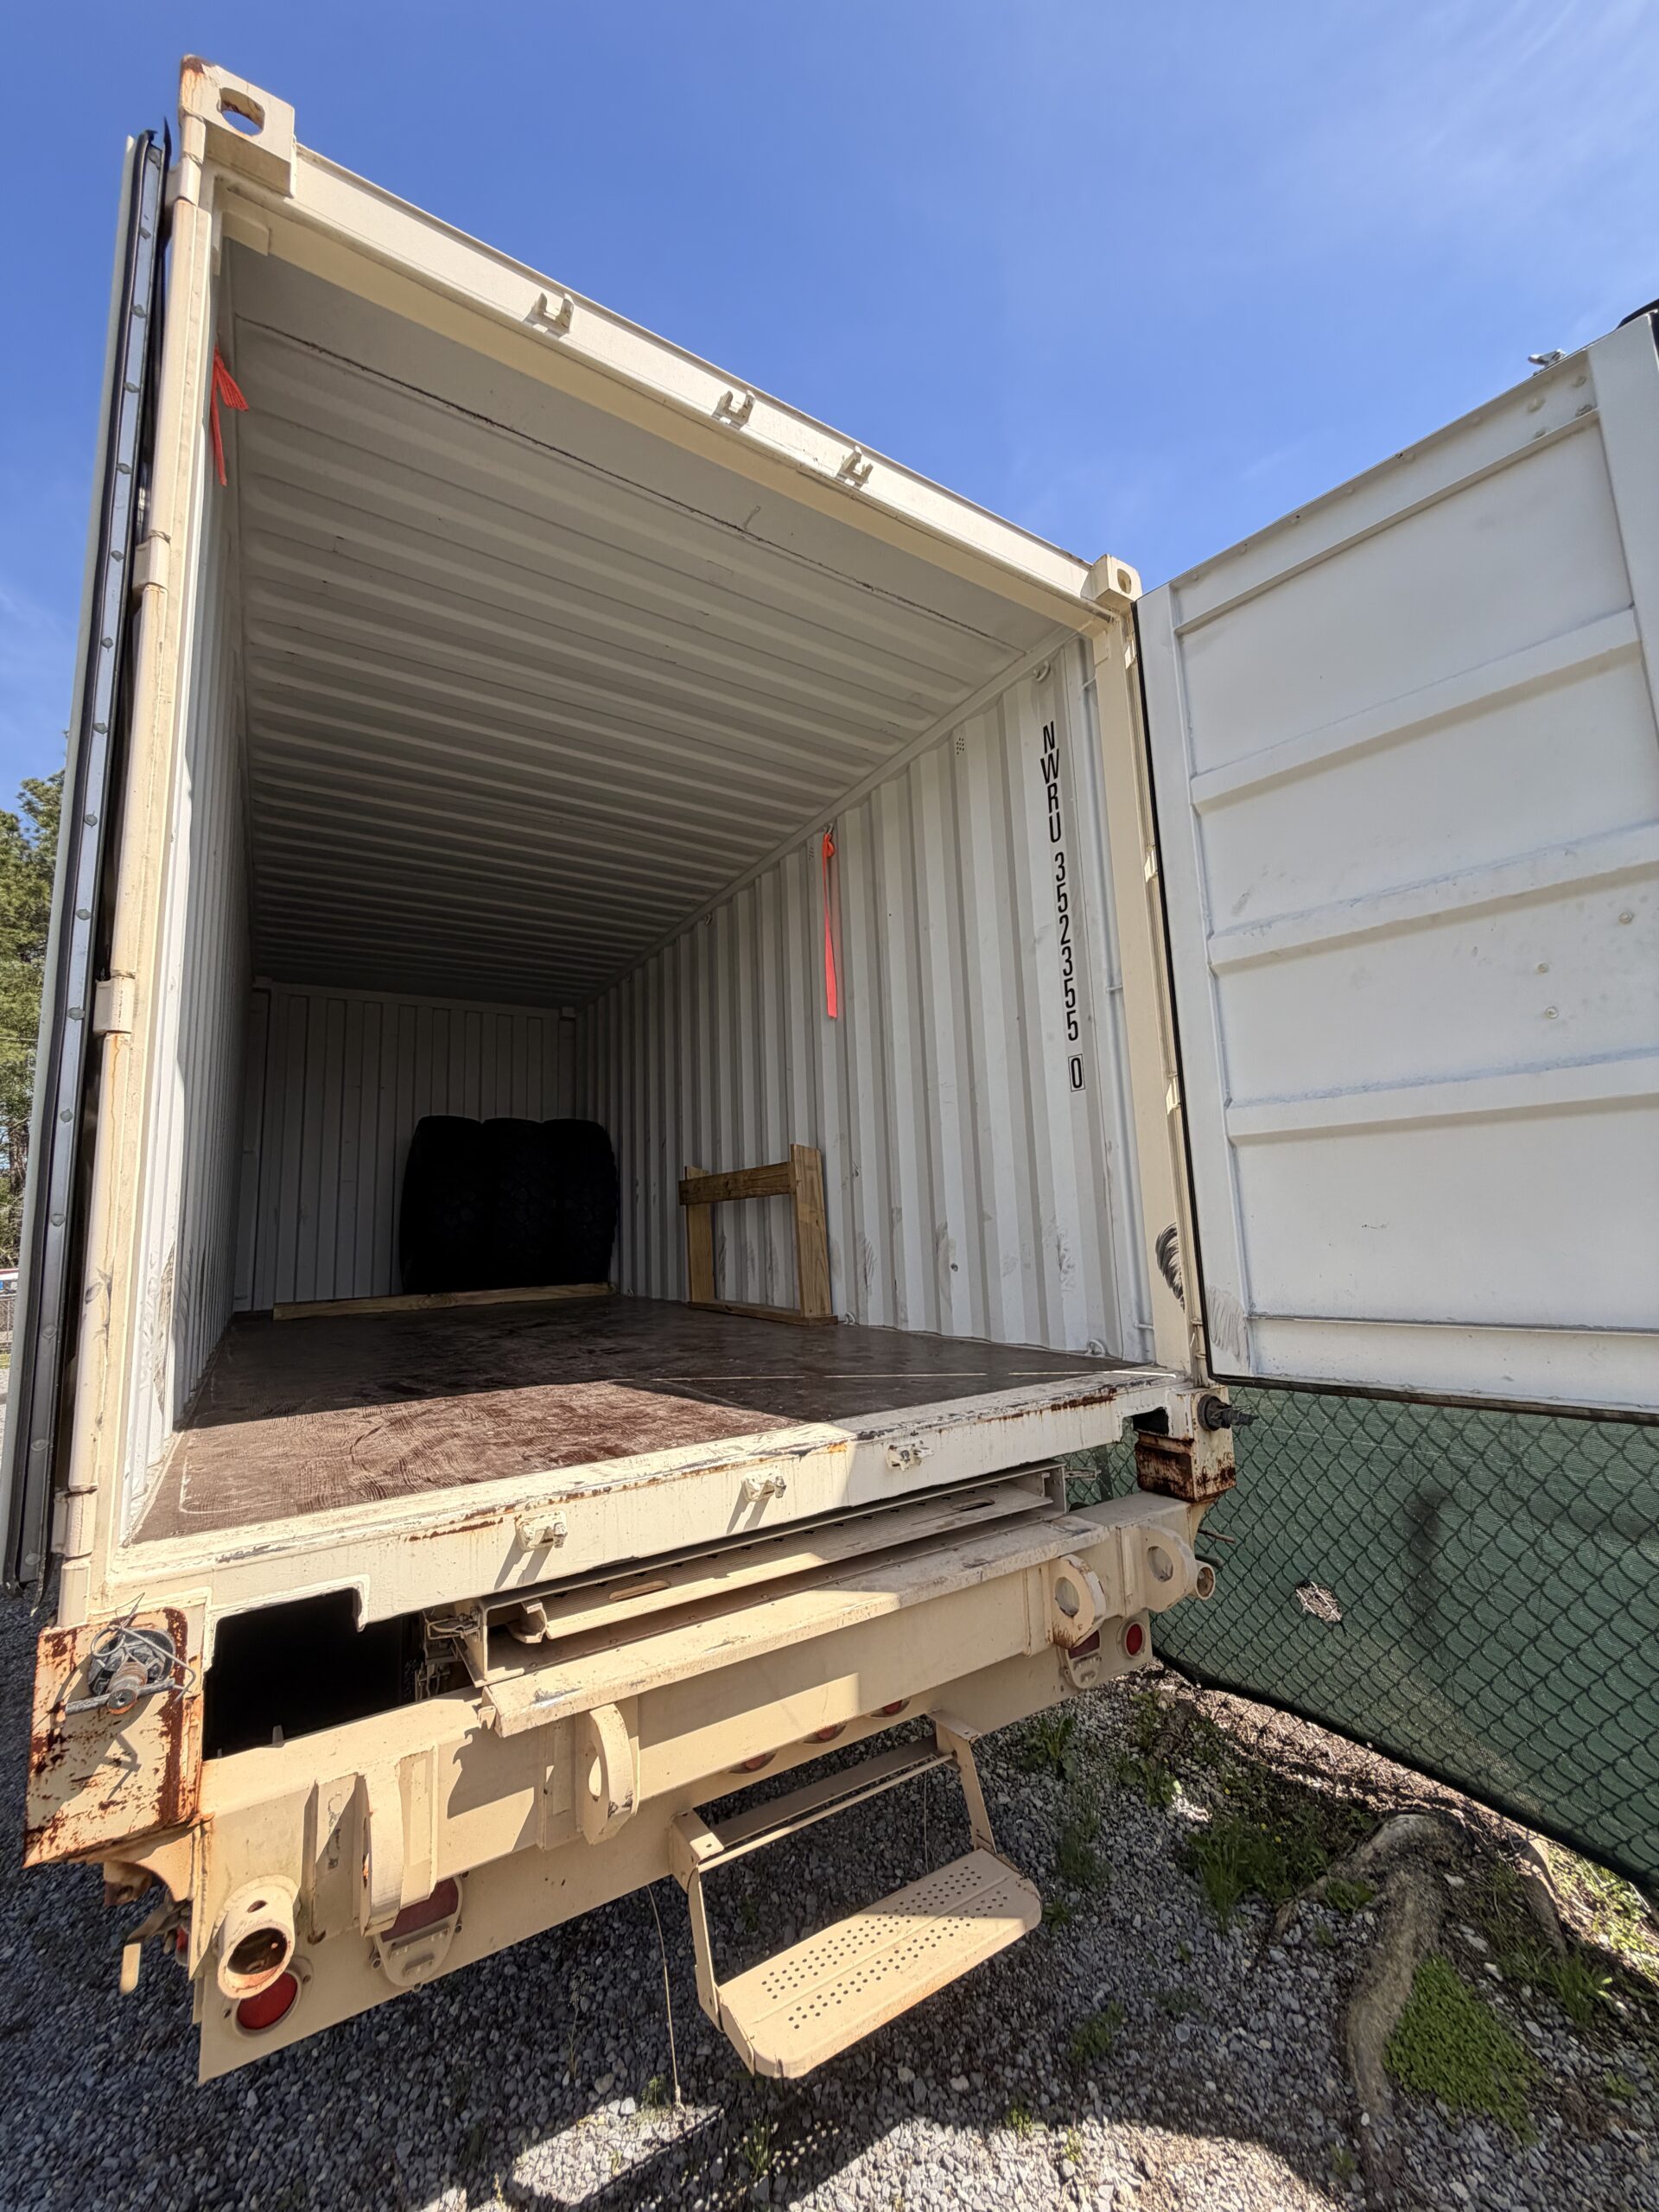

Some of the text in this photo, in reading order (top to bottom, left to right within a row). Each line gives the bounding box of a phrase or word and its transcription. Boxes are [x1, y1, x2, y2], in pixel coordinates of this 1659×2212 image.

[1040, 721, 1084, 1090] NWRU 352355 0
